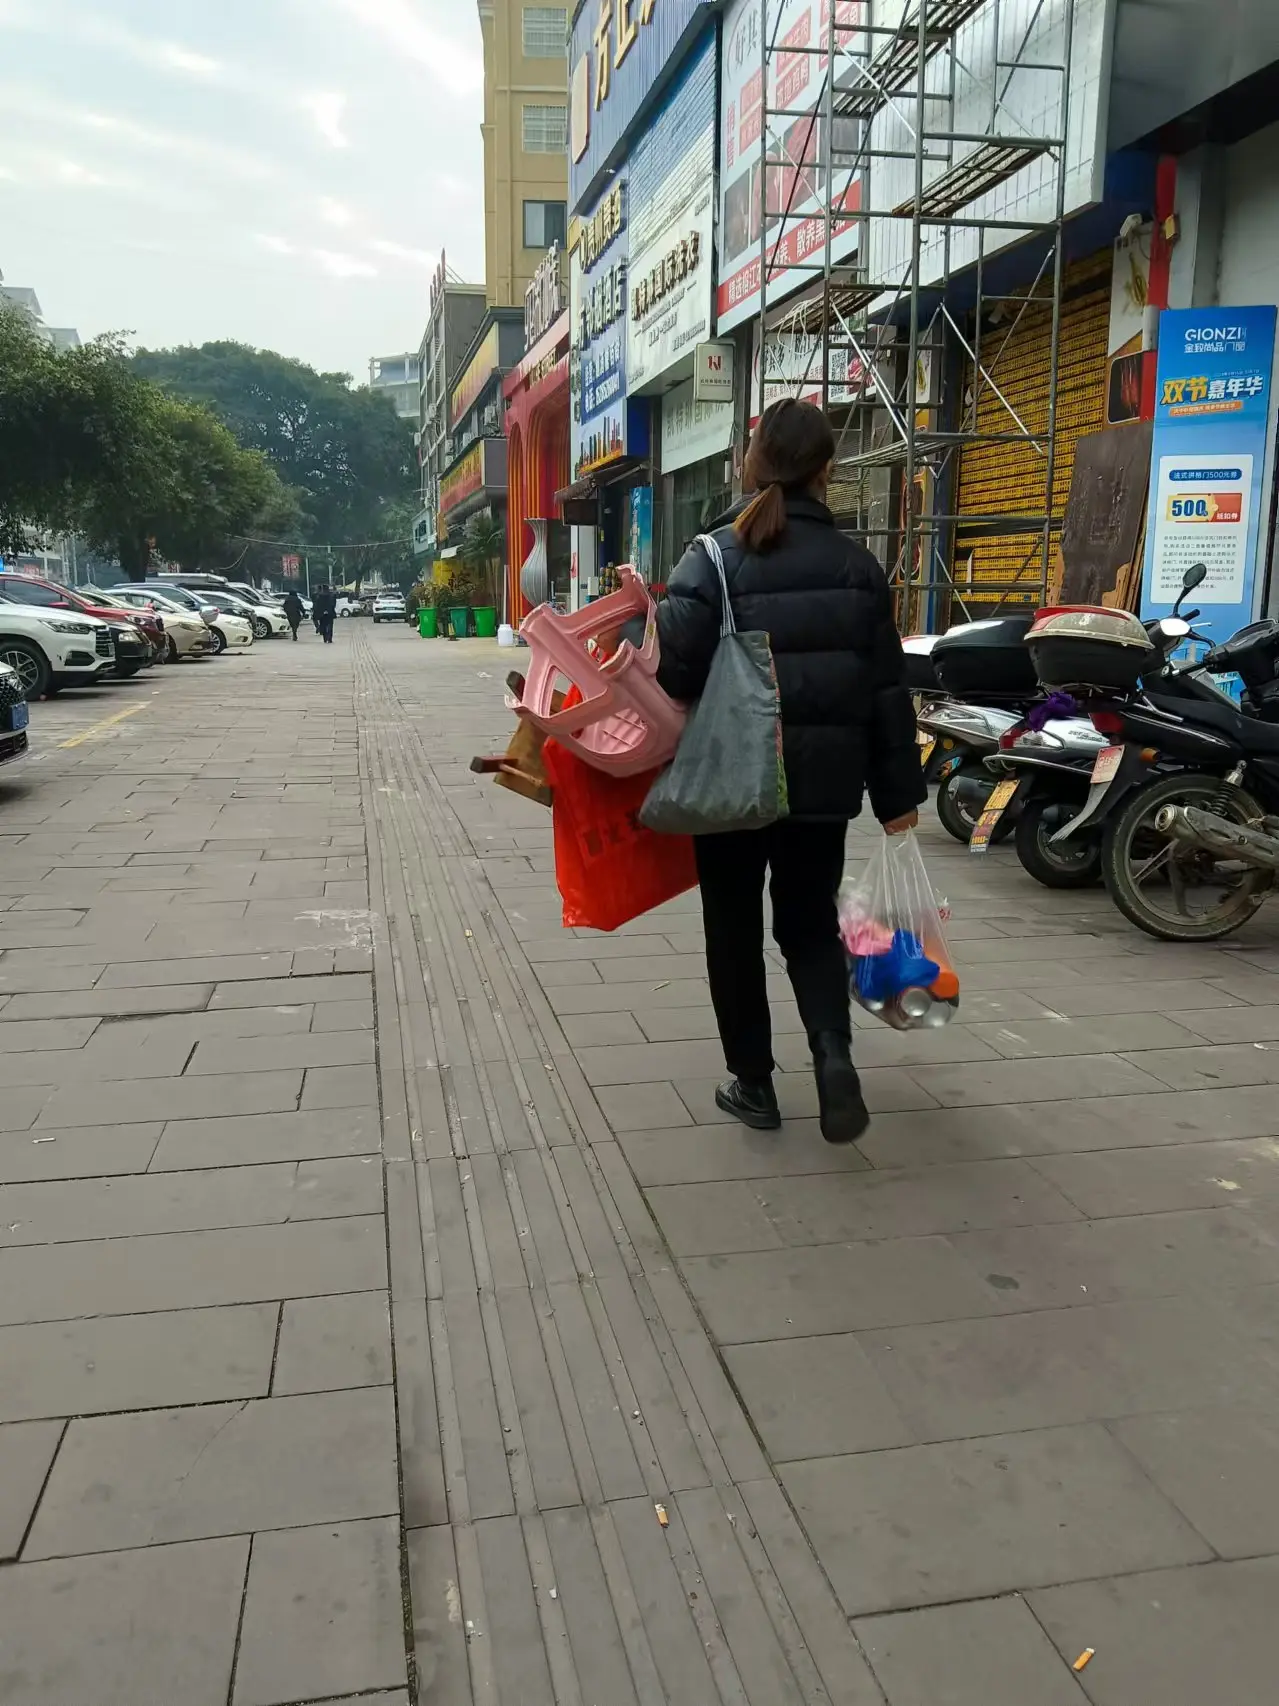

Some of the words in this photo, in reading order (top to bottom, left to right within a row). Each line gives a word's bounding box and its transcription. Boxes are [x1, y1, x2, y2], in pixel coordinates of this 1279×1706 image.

[1184, 327, 1241, 341] GIONZI
[1161, 375, 1263, 404] 双节嘉年华
